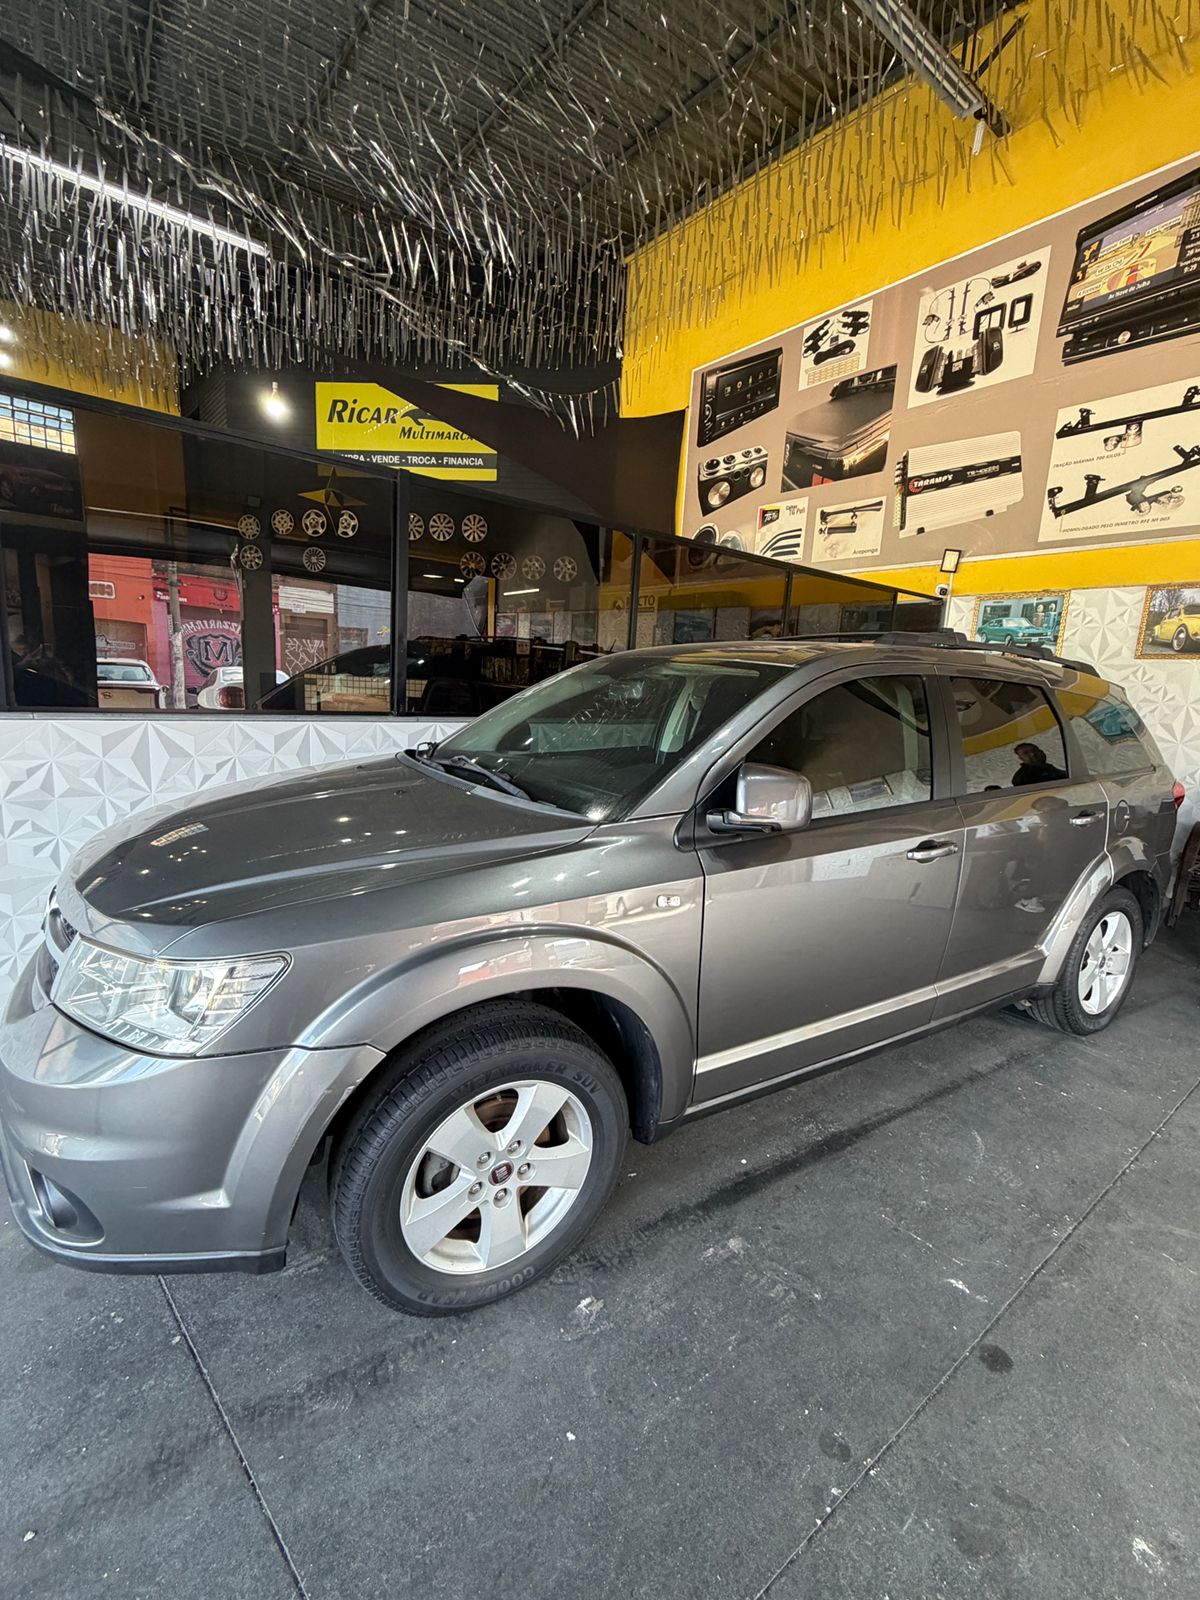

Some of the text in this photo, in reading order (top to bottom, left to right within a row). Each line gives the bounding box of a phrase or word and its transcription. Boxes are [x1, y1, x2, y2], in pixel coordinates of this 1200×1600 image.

[371, 454, 400, 464] VENDE
[407, 456, 436, 465] TROCA
[443, 456, 484, 466] FINANCIA
[572, 1070, 601, 1095] SUV
